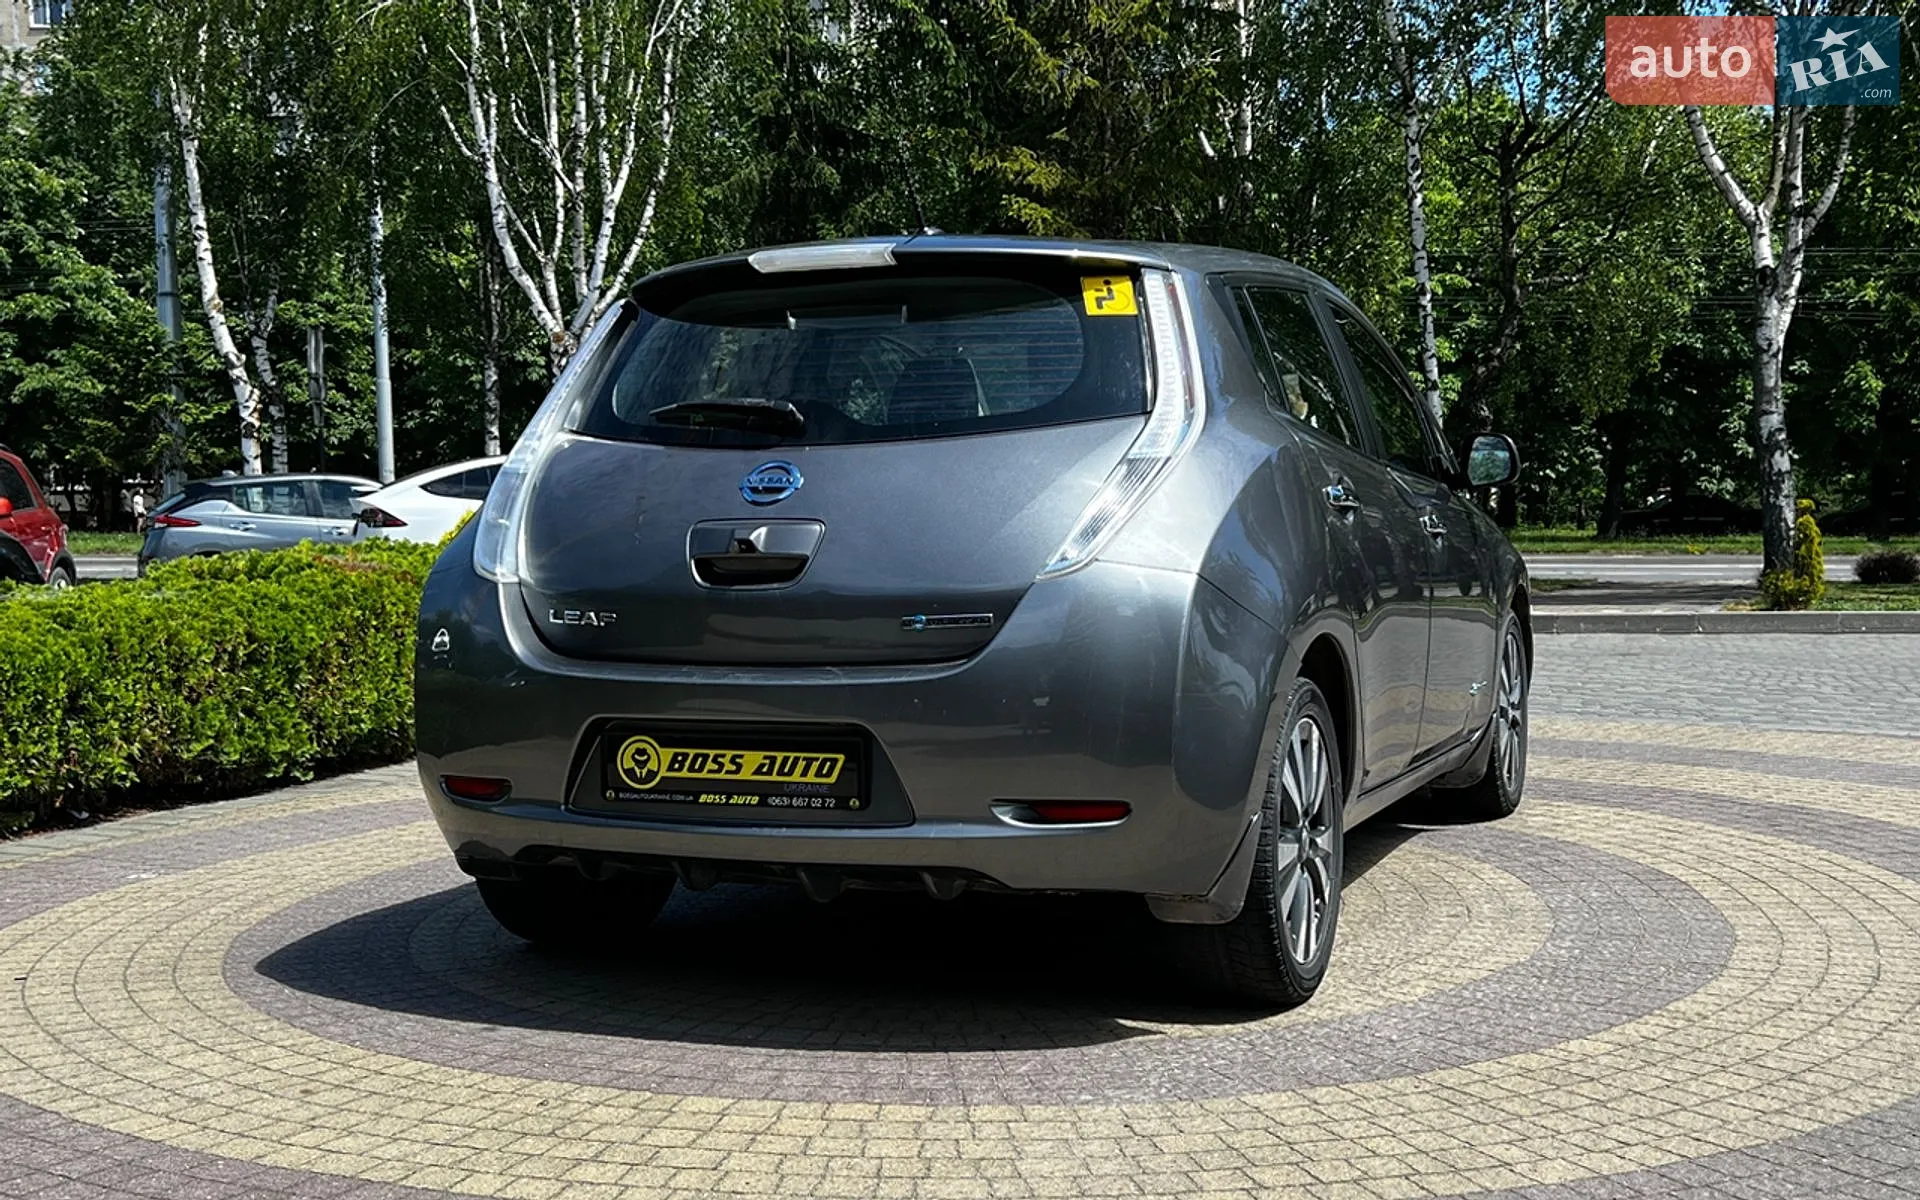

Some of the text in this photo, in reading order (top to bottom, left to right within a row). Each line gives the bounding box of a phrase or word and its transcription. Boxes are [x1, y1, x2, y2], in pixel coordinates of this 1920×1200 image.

[548, 609, 617, 626] LEAF
[666, 752, 840, 778] BOSS AUTO
[784, 783, 831, 793] UKRAINE
[698, 793, 760, 805] BOSS AUTO
[767, 796, 836, 808] (063) 667 02 72
